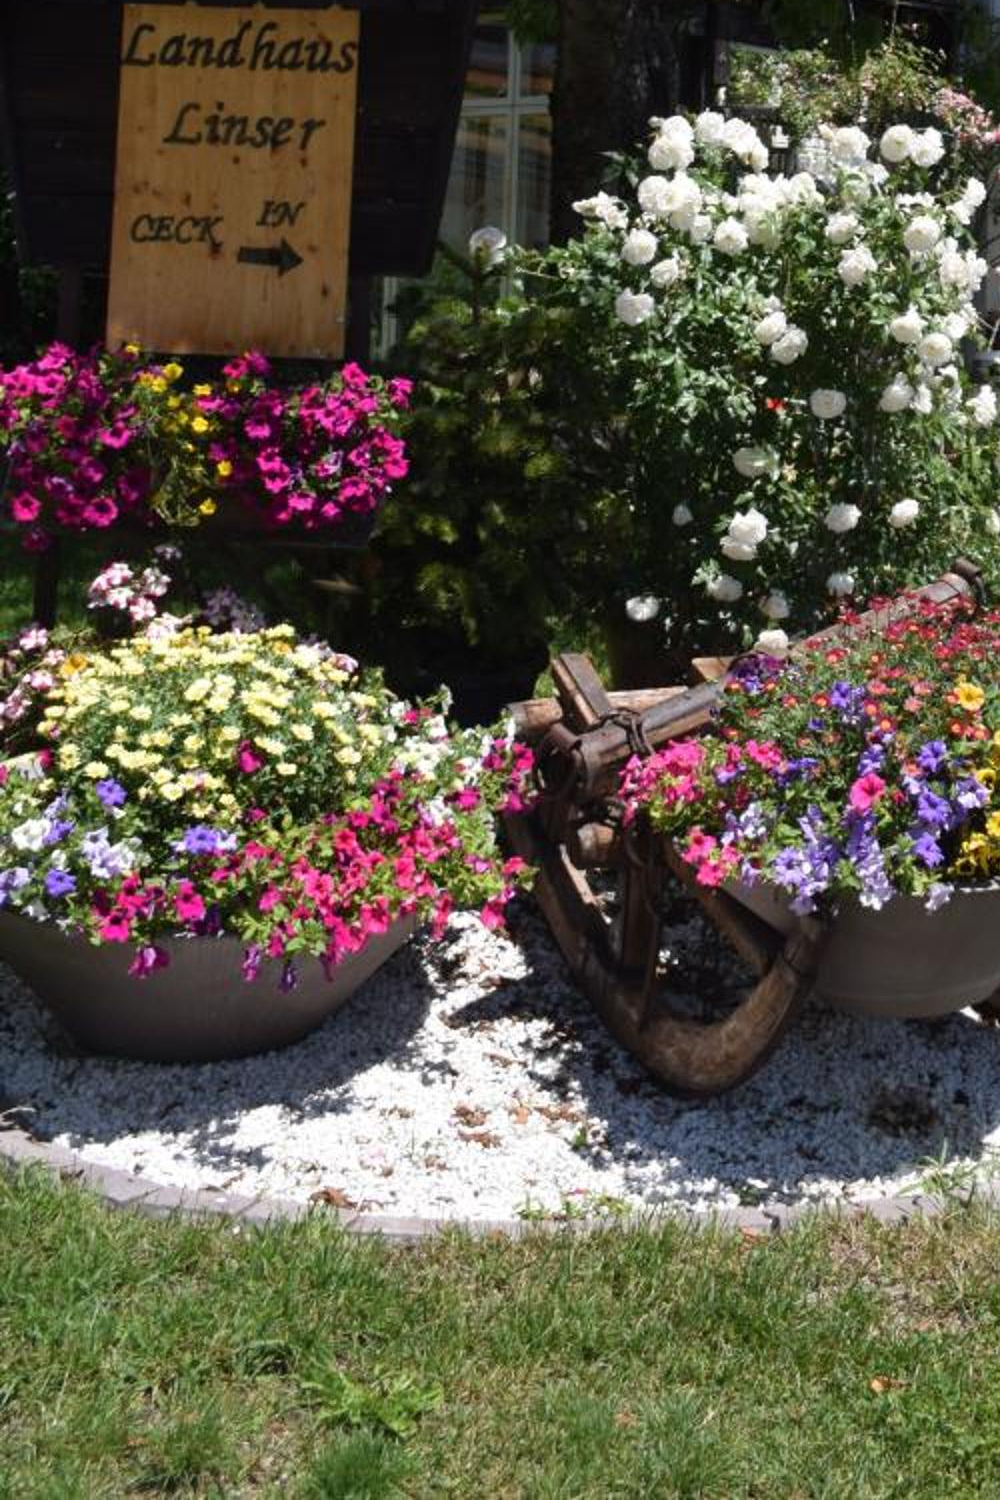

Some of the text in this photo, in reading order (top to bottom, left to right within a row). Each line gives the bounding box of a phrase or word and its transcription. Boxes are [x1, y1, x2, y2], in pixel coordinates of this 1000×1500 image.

[123, 20, 357, 73] Landhaus
[164, 102, 325, 151] Linser
[130, 200, 305, 250] CECK IN
